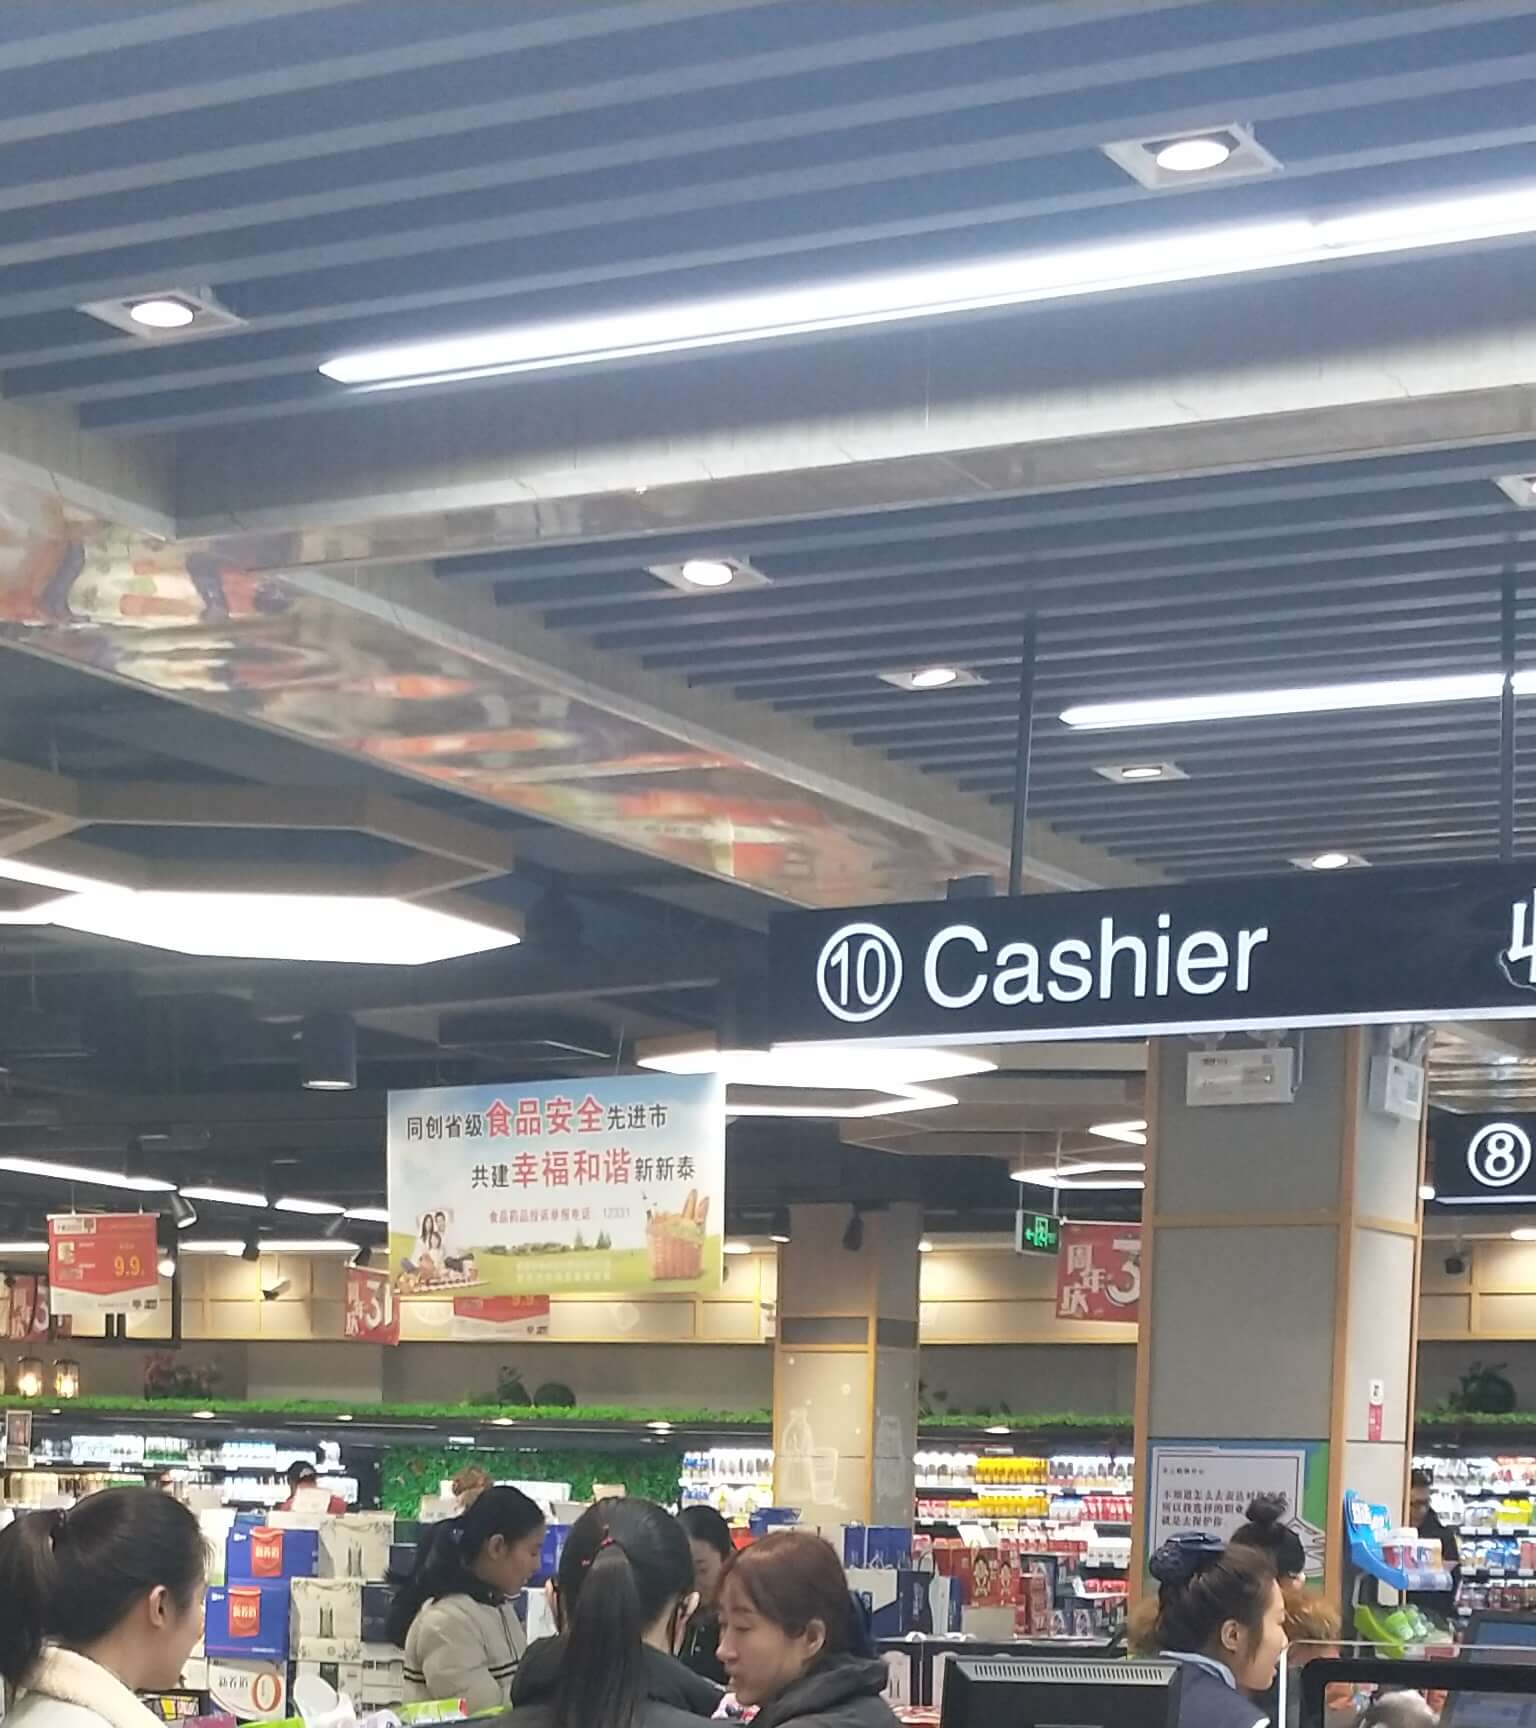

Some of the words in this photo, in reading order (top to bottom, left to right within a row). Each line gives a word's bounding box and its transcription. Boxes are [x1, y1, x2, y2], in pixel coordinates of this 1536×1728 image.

[924, 913, 1269, 1009] Cashier
[406, 1096, 669, 1141] 同创省级食品安全先进市
[471, 1147, 696, 1189] 共建幸福和谐新新泰
[1106, 1239, 1141, 1305] 3
[365, 1279, 393, 1330] 31
